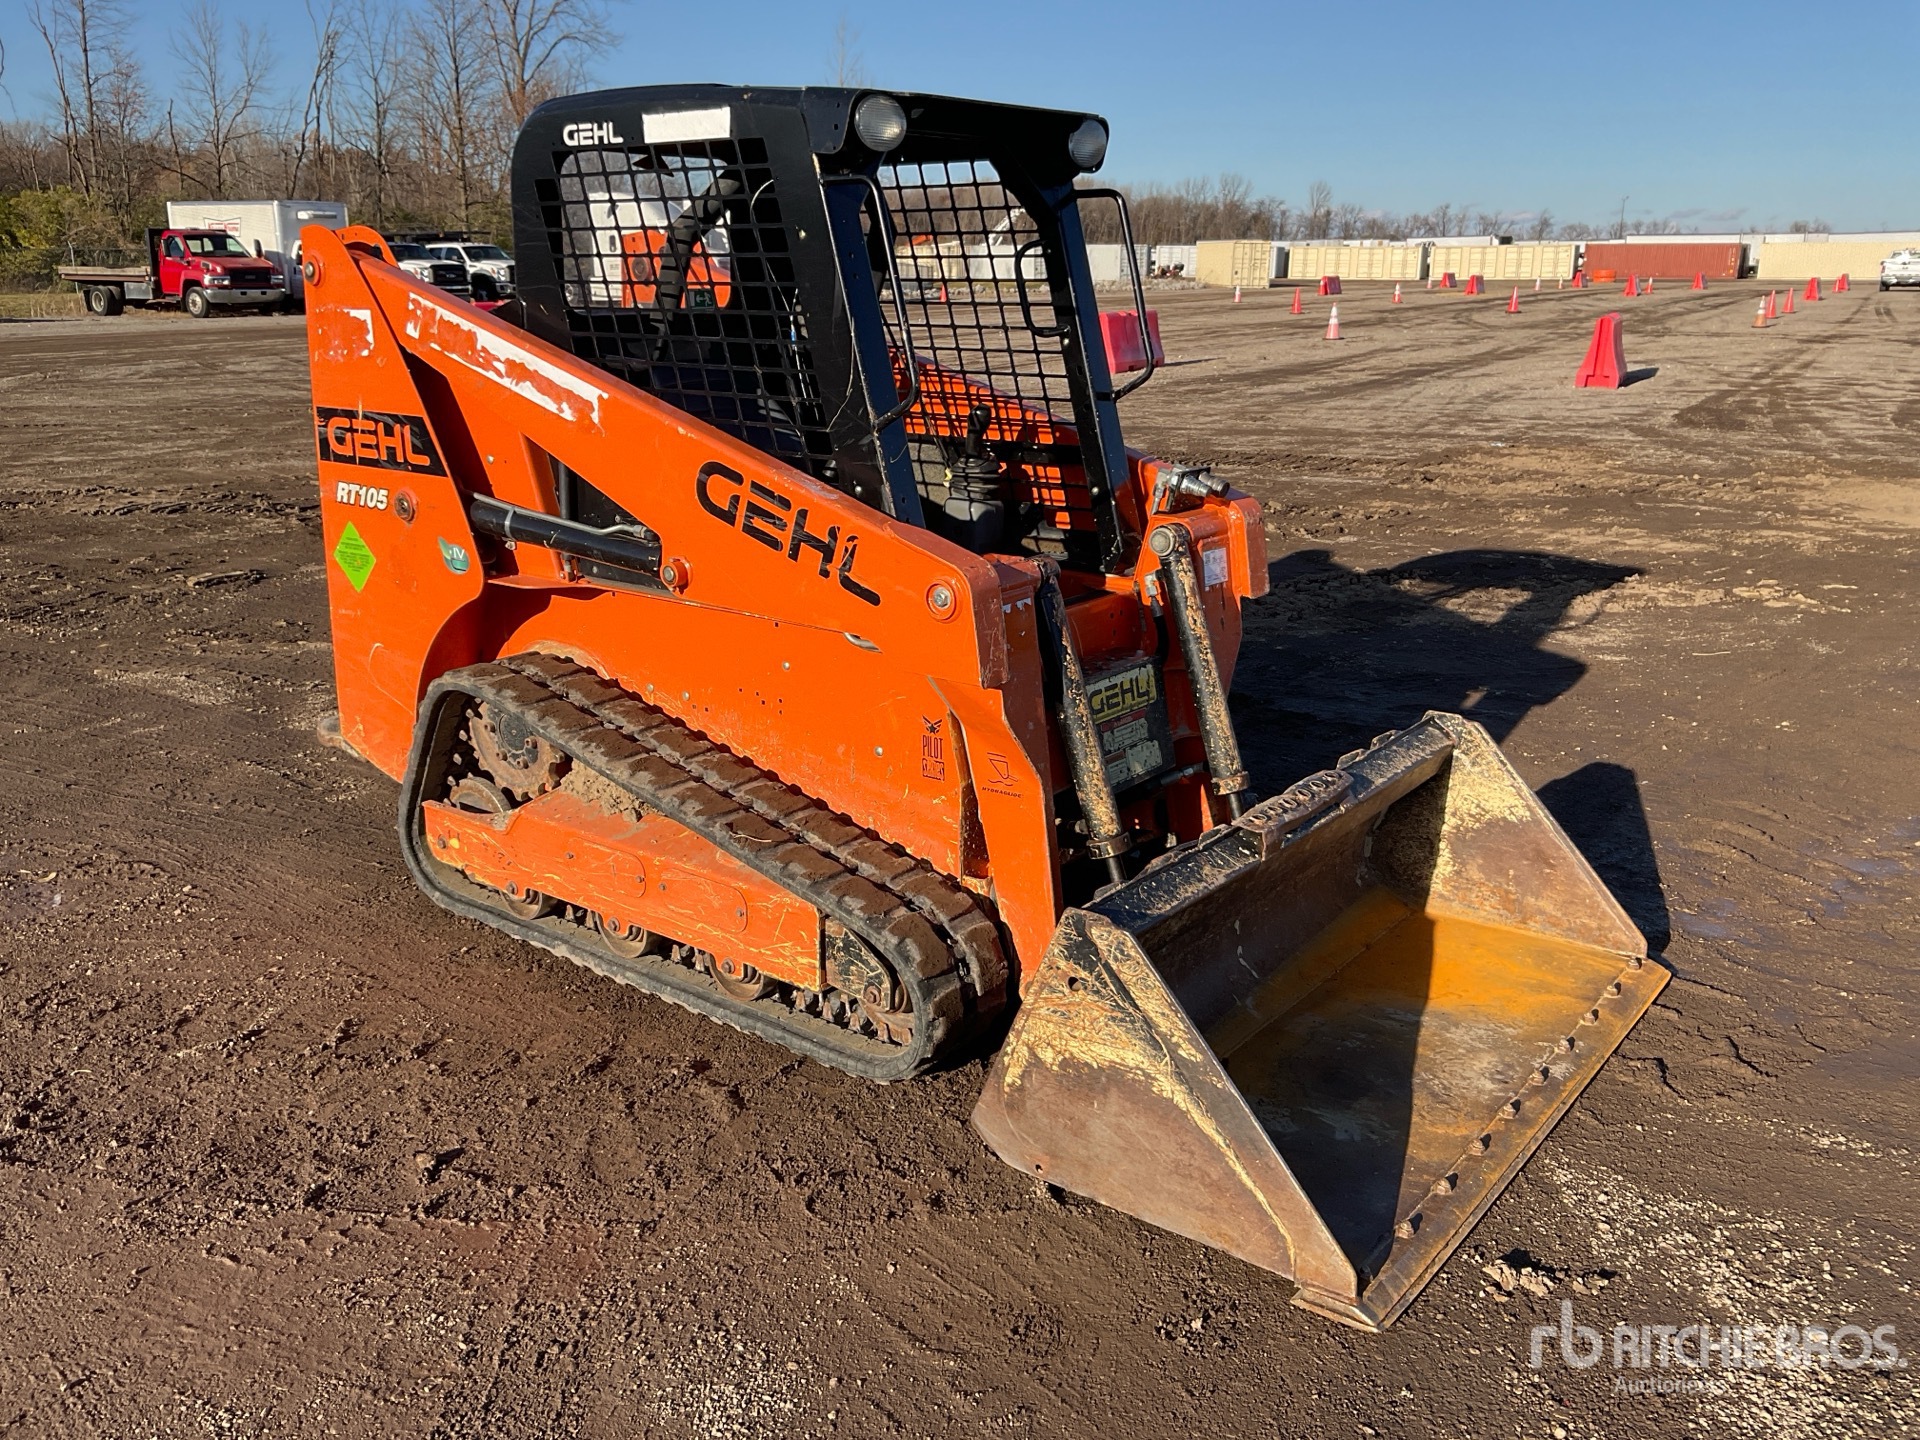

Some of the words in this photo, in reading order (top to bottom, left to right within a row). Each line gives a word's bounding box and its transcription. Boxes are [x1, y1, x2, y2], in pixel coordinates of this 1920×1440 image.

[562, 121, 624, 147] GEHL
[326, 416, 431, 467] GEHL
[336, 481, 389, 510] RT105
[696, 461, 881, 607] GEHL
[1089, 675, 1149, 715] GEHL
[922, 734, 943, 760] PILOT
